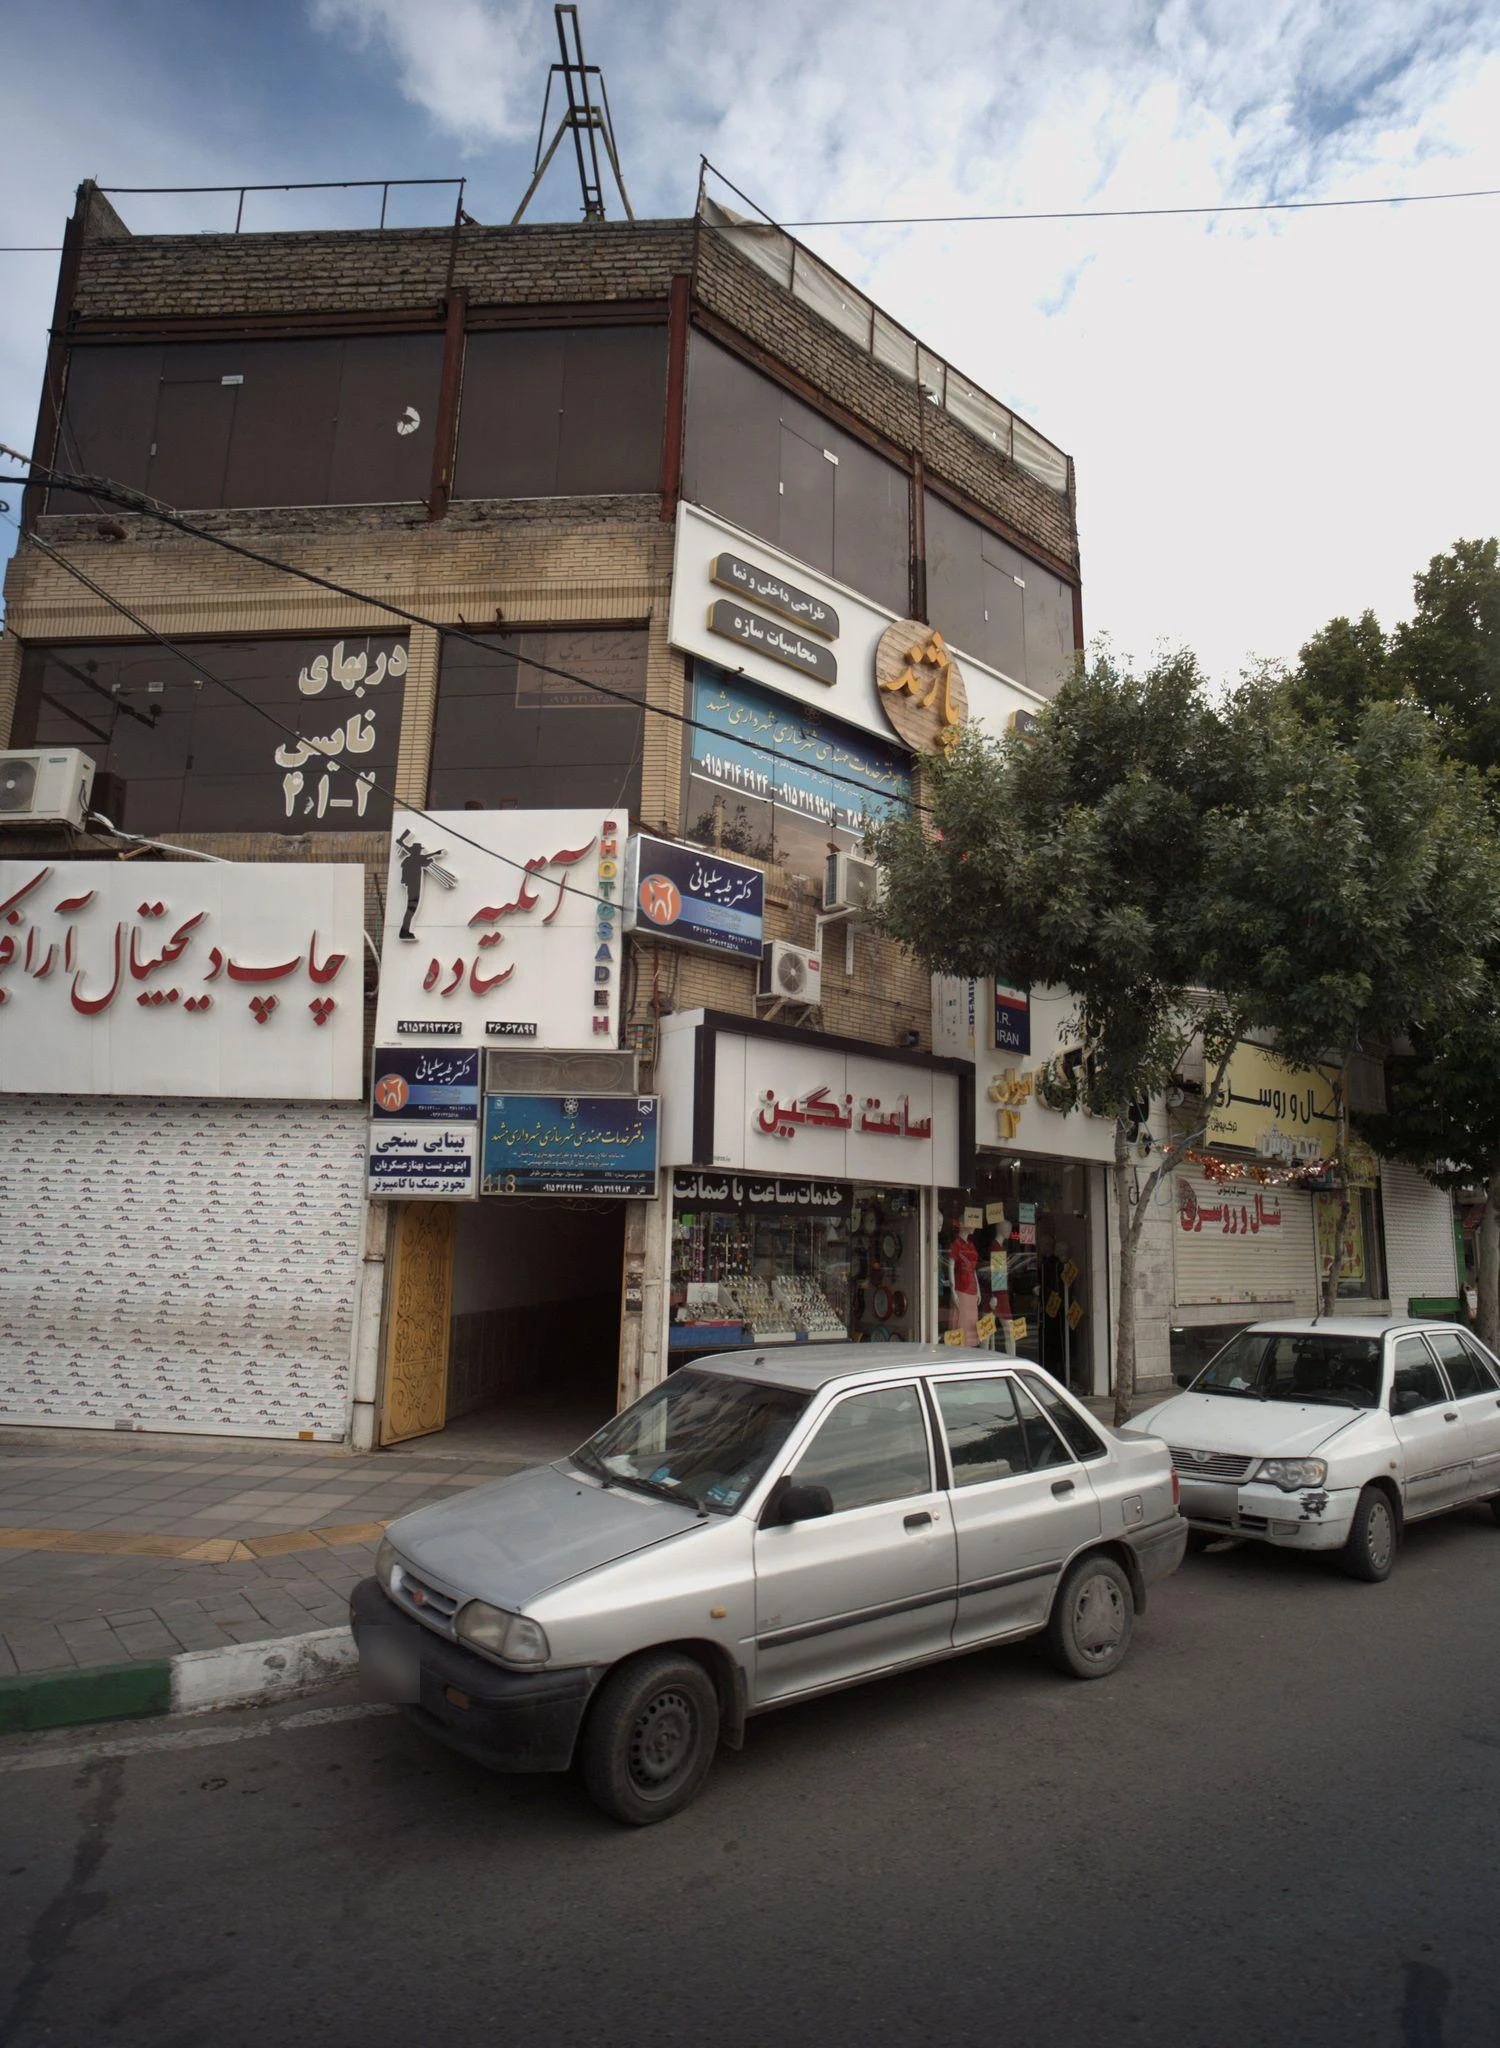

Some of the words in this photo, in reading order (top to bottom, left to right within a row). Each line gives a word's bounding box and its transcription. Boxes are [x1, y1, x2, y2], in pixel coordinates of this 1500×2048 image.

[733, 564, 747, 580] نما
[757, 582, 789, 602] داخلی
[791, 601, 826, 620] طراحی
[734, 617, 763, 639] سازه
[767, 632, 818, 664] محاسبات
[706, 691, 730, 711] مشهد
[689, 861, 722, 897] سلیمانی
[727, 875, 758, 907] دکتر
[468, 836, 597, 948] آتلیه
[70, 900, 223, 1015] دیجیتال
[227, 930, 348, 1026] چاپ
[423, 956, 516, 997] ساده
[996, 1030, 1020, 1046] IRAN
[415, 1055, 444, 1081] سلیمانی
[450, 1053, 477, 1085] دکتر
[756, 1086, 853, 1139] نگین
[858, 1094, 932, 1139] ساعت
[1290, 1094, 1298, 1121] و
[376, 1131, 418, 1153] سنجی
[423, 1131, 466, 1153] بینایی
[491, 1122, 509, 1141] مشهد
[507, 1121, 542, 1146] شهرداری
[539, 1122, 575, 1147] شهرسازی
[574, 1130, 602, 1147] مهندسی
[601, 1127, 630, 1145] خدمات
[628, 1123, 645, 1147] دفتر
[373, 1178, 408, 1192] کامپیوتر
[409, 1178, 415, 1192] با
[417, 1178, 439, 1192] عینک
[441, 1178, 466, 1192] تجویز
[673, 1175, 728, 1200] ضمانت
[731, 1177, 743, 1206] با
[750, 1180, 801, 1203] ساعت
[800, 1184, 842, 1206] خدمات
[1180, 1200, 1238, 1233] روسری
[1240, 1205, 1248, 1234] و
[1251, 1193, 1281, 1234] شال
